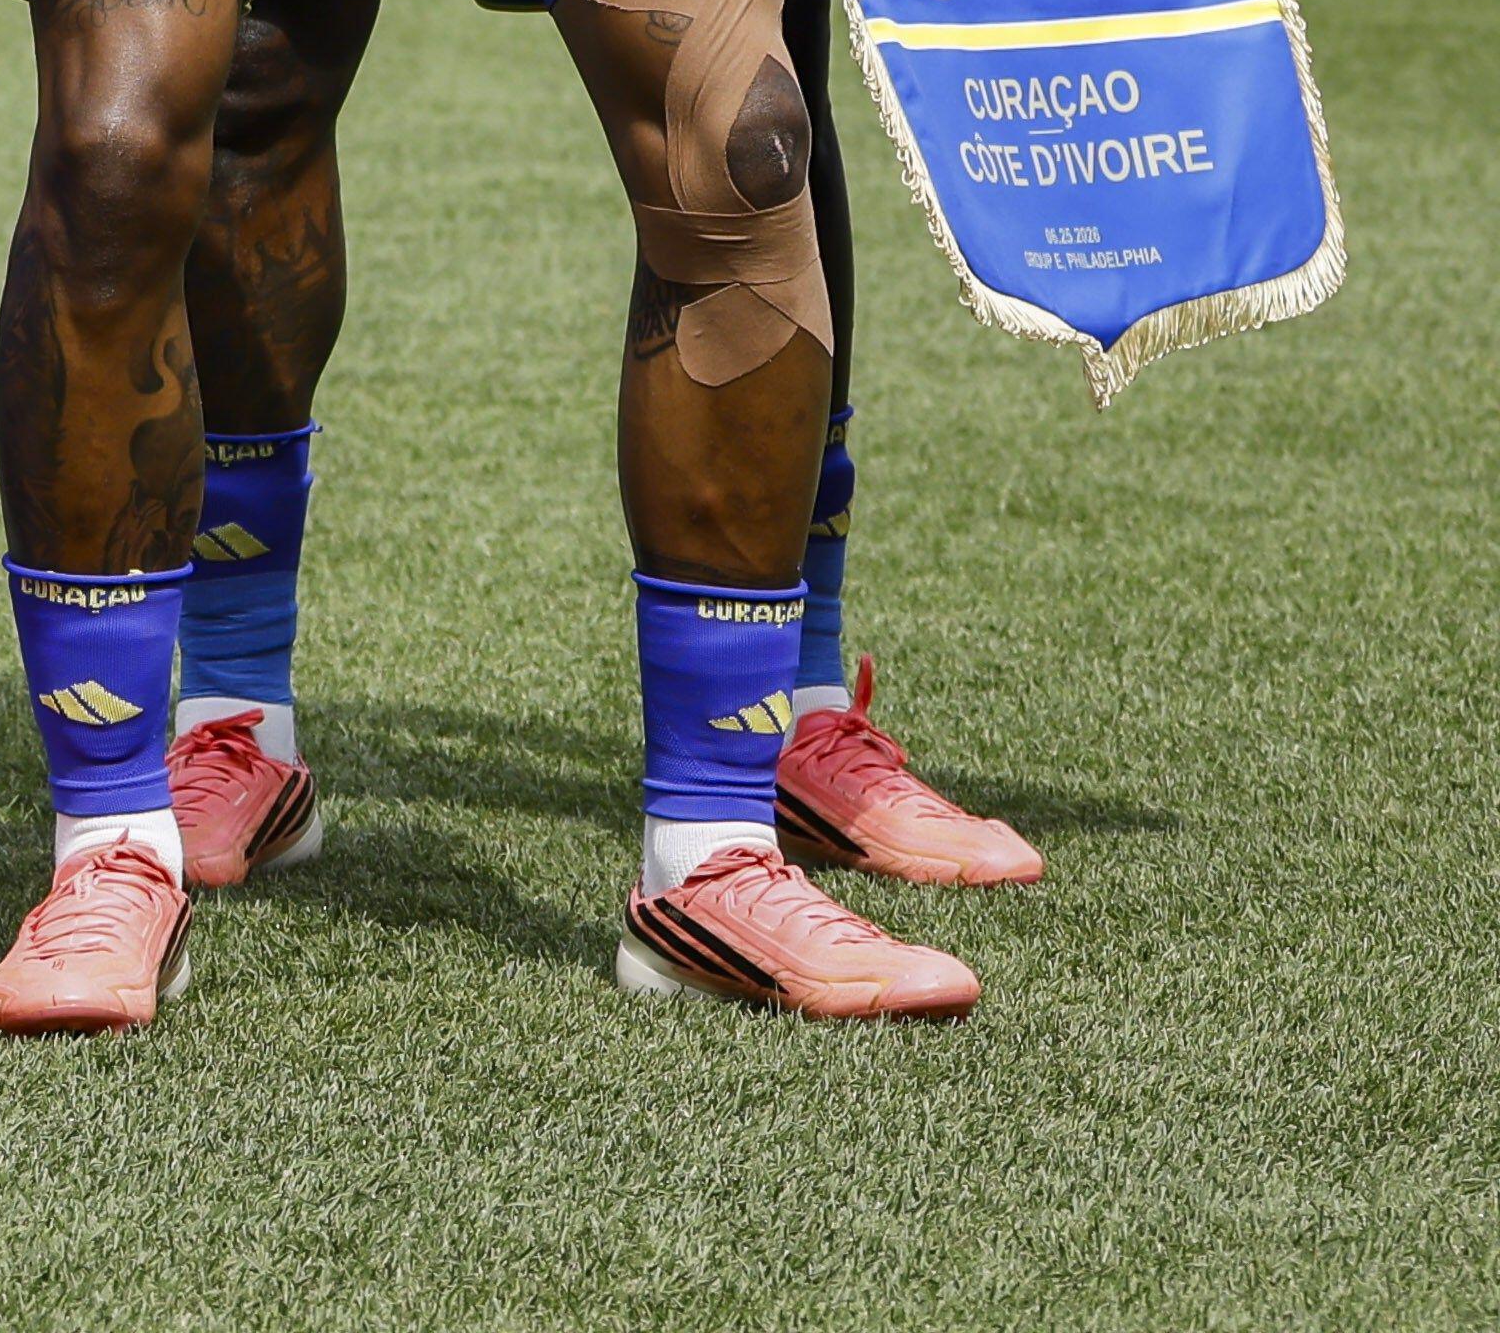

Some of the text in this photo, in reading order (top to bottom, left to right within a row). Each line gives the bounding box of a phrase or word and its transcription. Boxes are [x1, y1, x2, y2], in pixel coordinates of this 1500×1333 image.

[964, 70, 1141, 129] CURAÇAO
[959, 129, 1214, 187] CÔTE D'IVOIRE
[1024, 250, 1052, 271] GROUP
[1067, 246, 1163, 270] PHILADELPHIA
[19, 576, 147, 615] CURAÇAO
